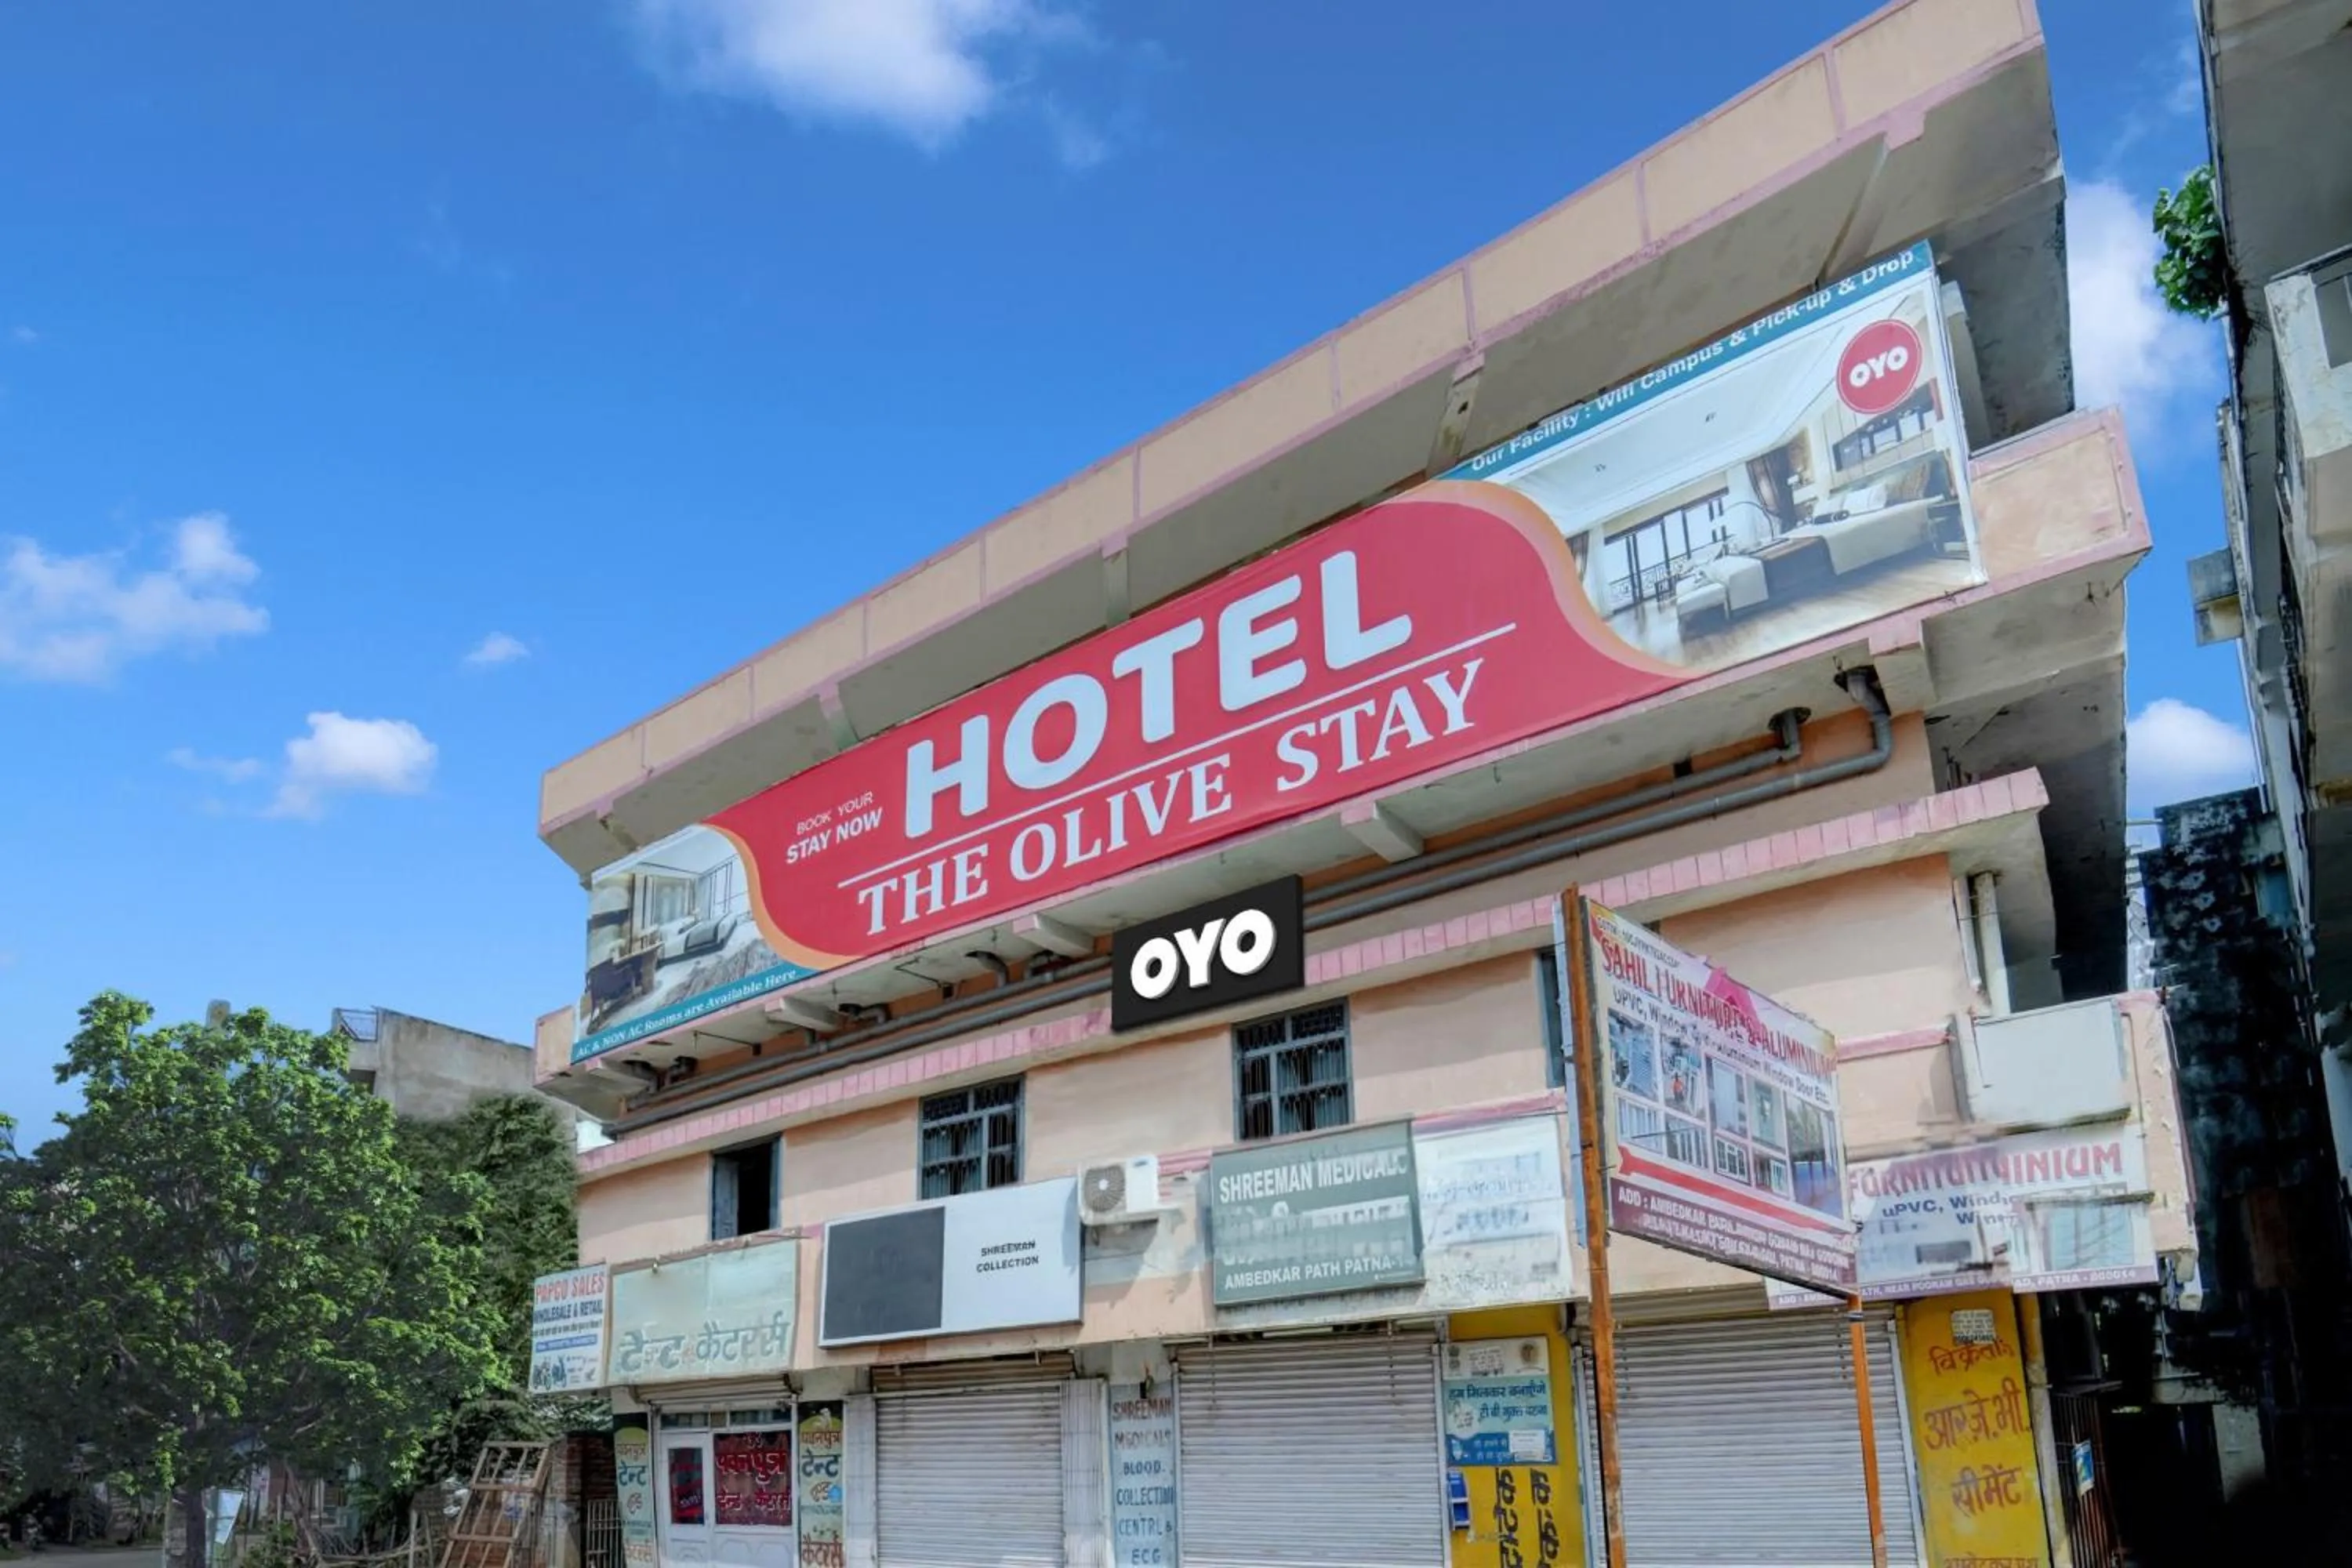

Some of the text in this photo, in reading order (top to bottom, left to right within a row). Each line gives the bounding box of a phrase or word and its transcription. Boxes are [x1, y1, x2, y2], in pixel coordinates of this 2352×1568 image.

[1471, 447, 1504, 471] Our
[1510, 411, 1580, 455] Facility
[1640, 339, 1725, 390] Campus
[1729, 328, 1748, 347] &
[1752, 289, 1831, 337] Pick-up
[1838, 278, 1857, 296] &
[1861, 249, 1914, 285] Drop
[1849, 345, 1909, 388] OYO
[903, 549, 1413, 840] HOTEL
[796, 791, 874, 836] BOOK YOUR
[857, 656, 1484, 938] THE OLIVE STAY
[786, 808, 883, 864] STAY NOW
[1129, 908, 1276, 1000] OYO
[1600, 936, 1653, 993] SAHIL
[627, 1025, 644, 1040] AC
[684, 1004, 706, 1018] are
[706, 981, 762, 1012] Available
[764, 968, 798, 992] Here
[1219, 1161, 1313, 1204] SHREEMAN
[976, 1254, 1040, 1273] COLLECTION
[980, 1240, 1036, 1257] SHREEMAN
[572, 1271, 605, 1298] SALES
[1224, 1265, 1301, 1291] AMBEDKAR
[1304, 1259, 1341, 1280] PATH
[1123, 1459, 1162, 1476] BLOOD
[1131, 1548, 1161, 1566] ECG
